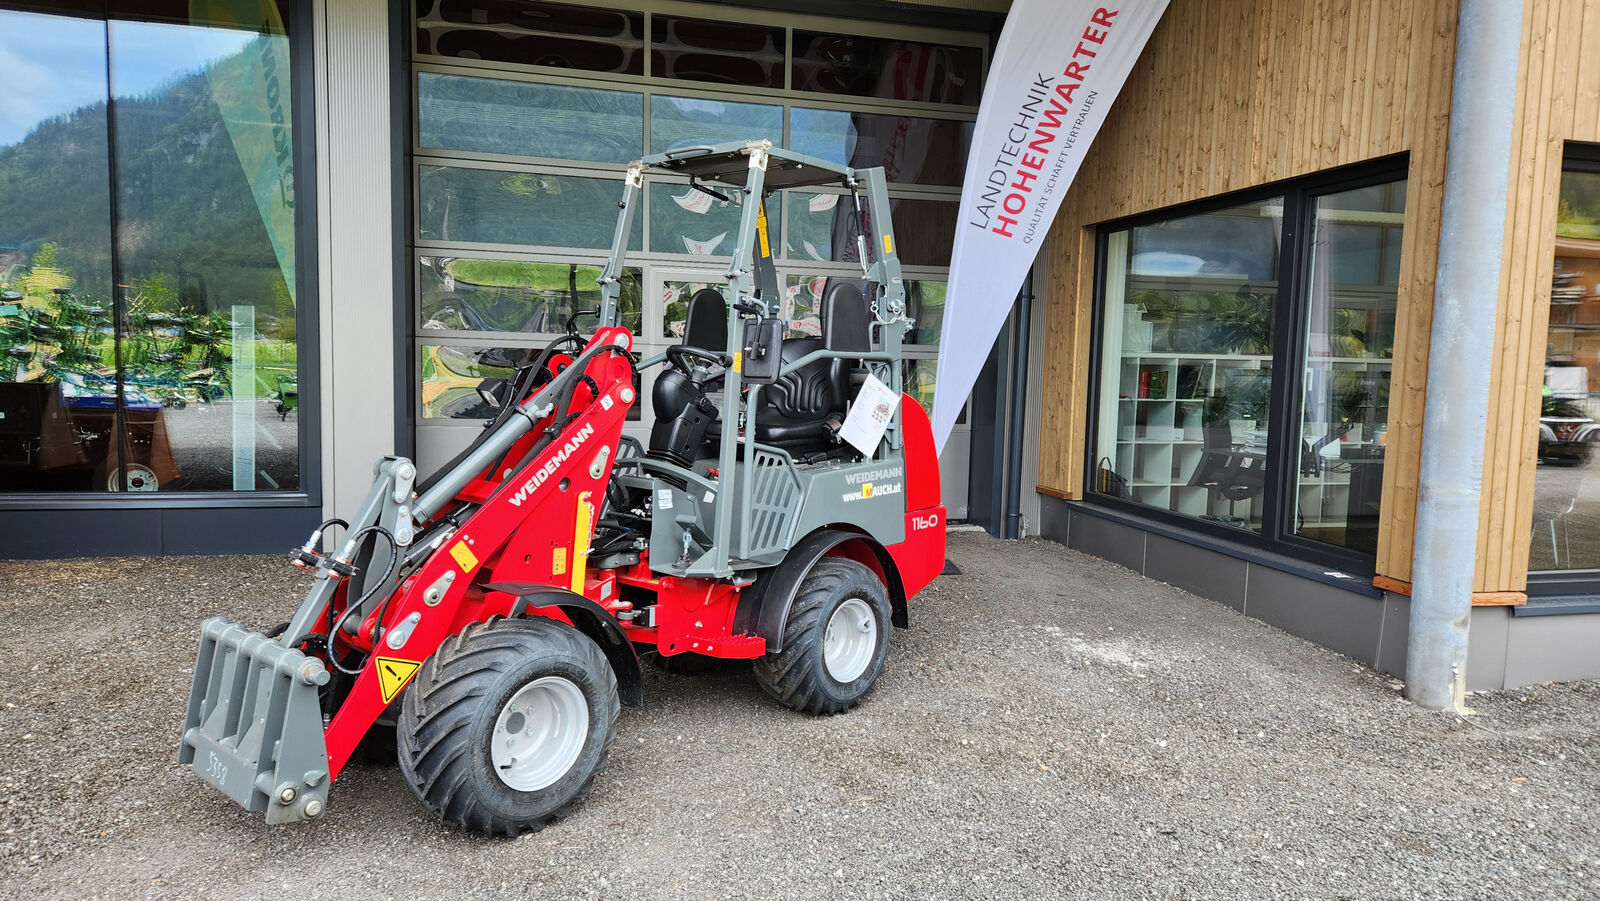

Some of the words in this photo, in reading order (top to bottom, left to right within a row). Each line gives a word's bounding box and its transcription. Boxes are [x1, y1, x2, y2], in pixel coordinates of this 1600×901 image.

[970, 72, 1055, 230] LANDTECHNIK
[992, 7, 1119, 238] HOHENWARTER
[1023, 195, 1049, 244] QUALITÄT
[1044, 150, 1069, 194] SCHAFFT
[1063, 90, 1098, 149] VERTRAUEN
[508, 422, 595, 507] WEIDEMANN
[845, 466, 902, 485] WEIDEMANN
[911, 513, 938, 531] 1160
